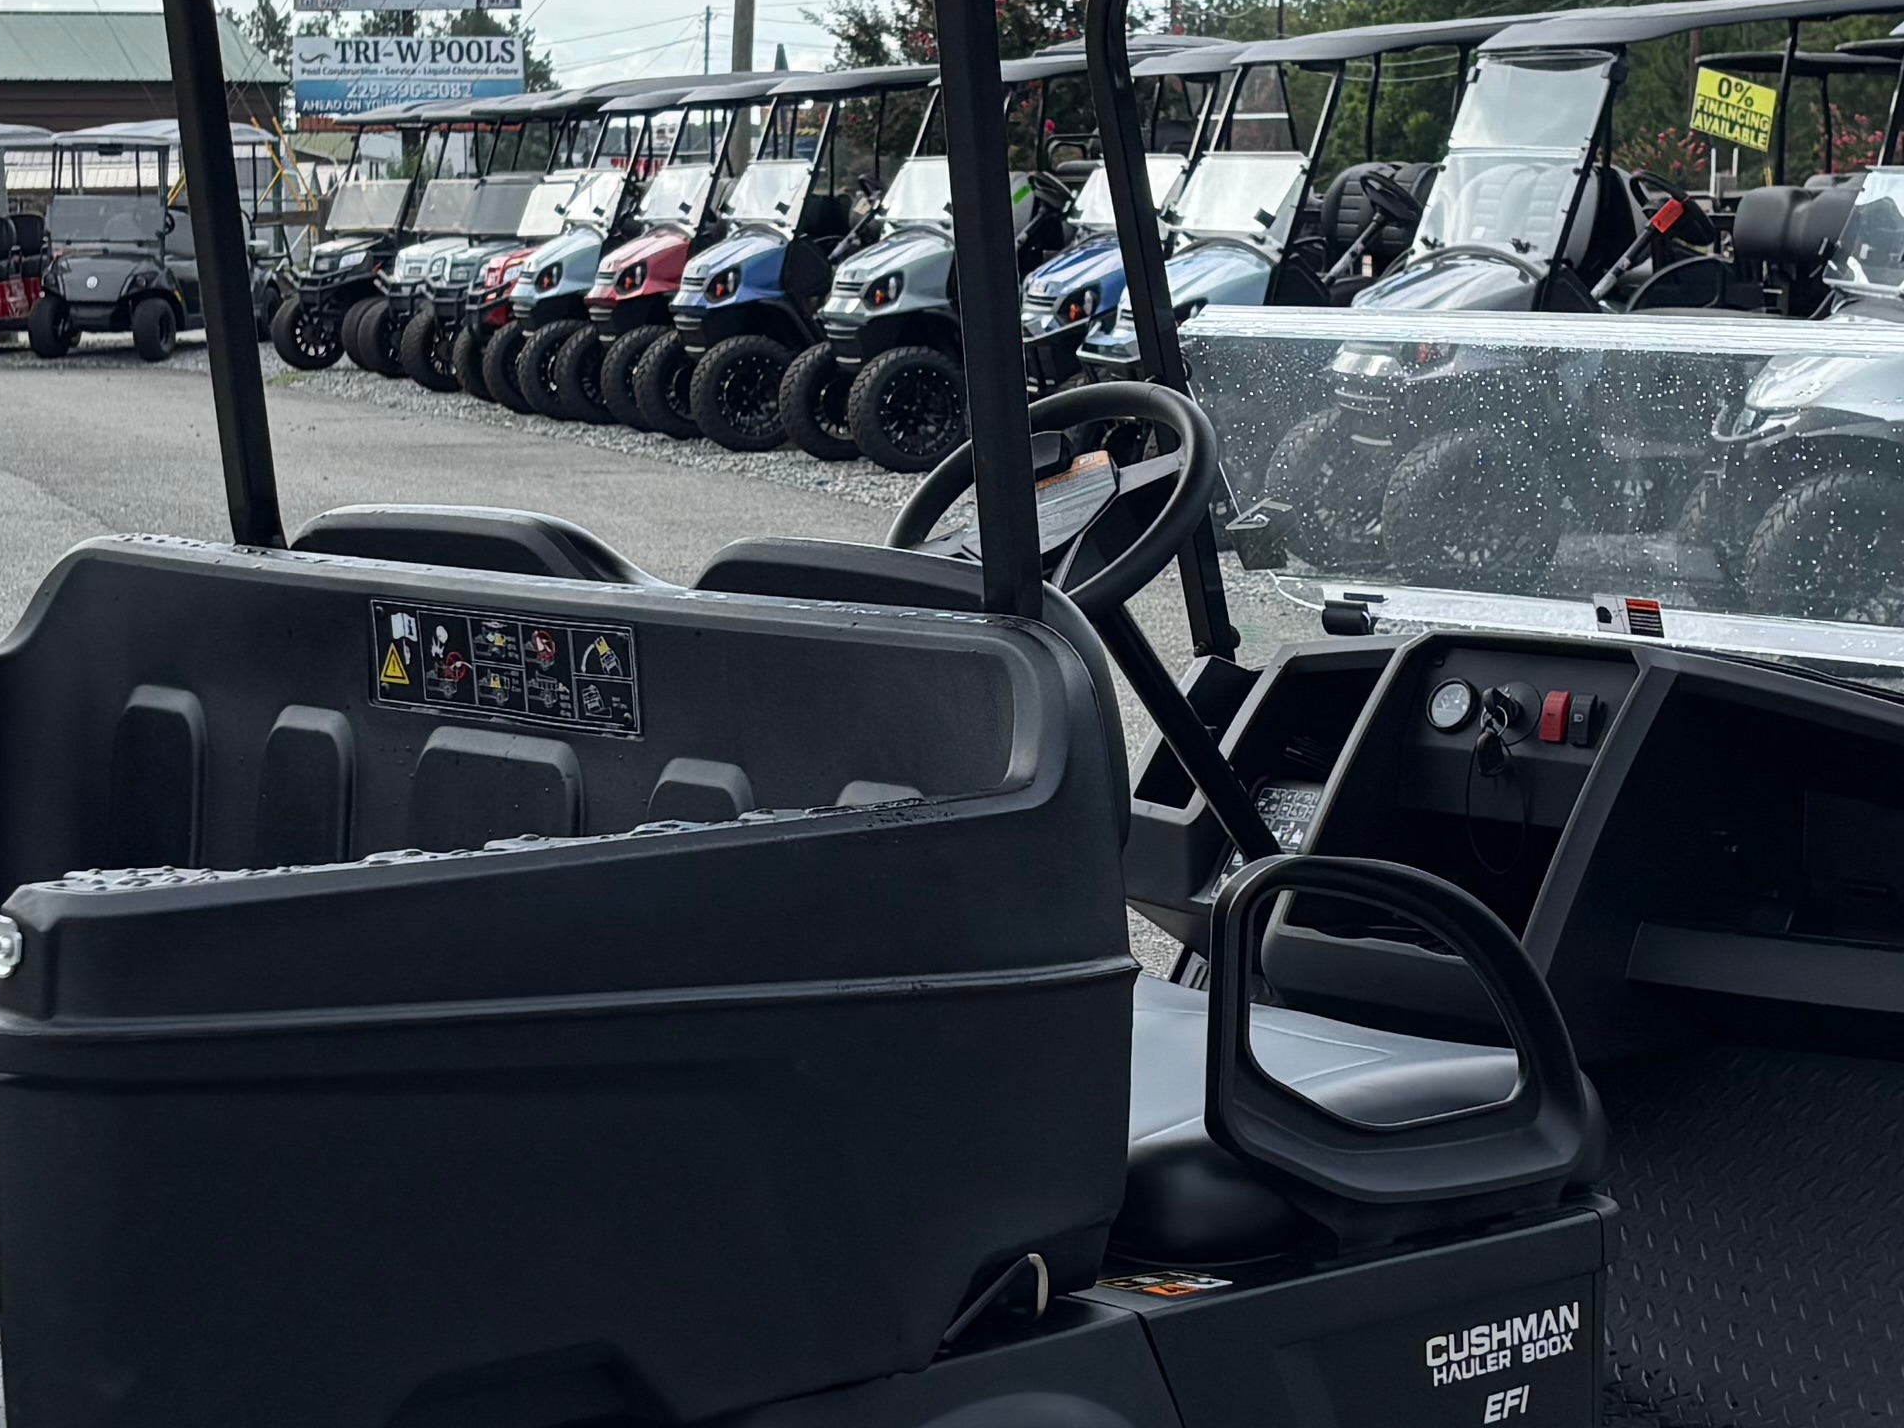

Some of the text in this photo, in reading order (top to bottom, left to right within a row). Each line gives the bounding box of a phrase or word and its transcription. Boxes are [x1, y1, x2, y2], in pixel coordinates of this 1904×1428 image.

[335, 40, 515, 65] TRI-W POOLS
[1717, 77, 1754, 108] 0%
[1693, 112, 1767, 150] AVAILABLE
[1697, 97, 1770, 132] FINANCING
[1426, 1301, 1579, 1367] CUSHMAN
[1433, 1332, 1574, 1387] HAULER 800X
[1484, 1385, 1530, 1424] EFI
